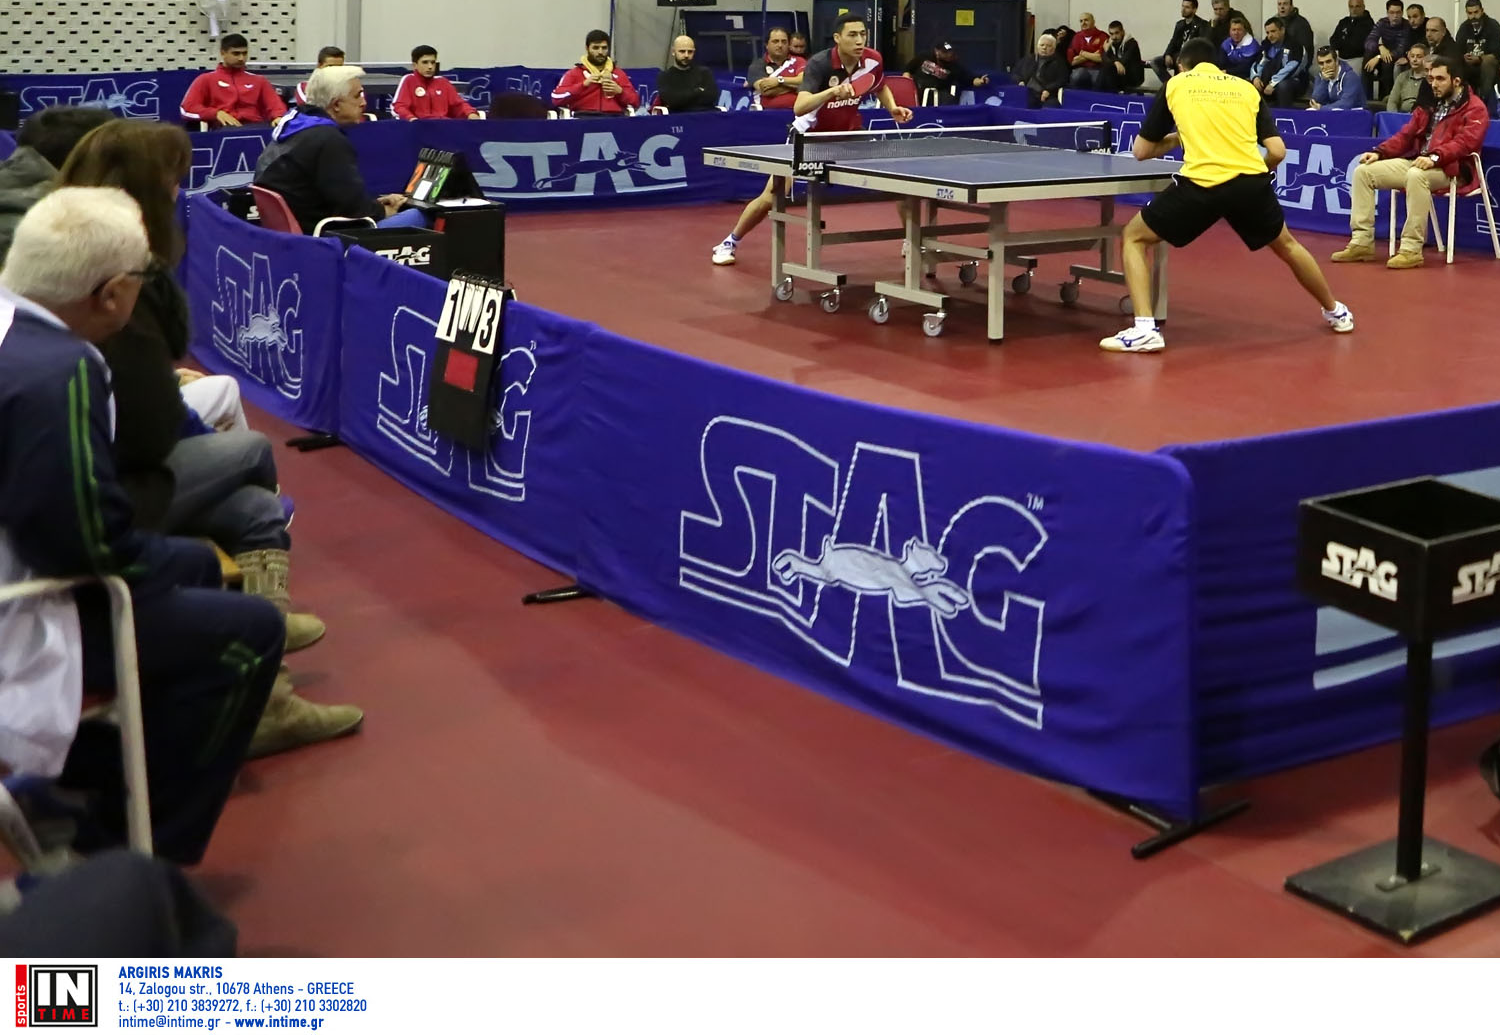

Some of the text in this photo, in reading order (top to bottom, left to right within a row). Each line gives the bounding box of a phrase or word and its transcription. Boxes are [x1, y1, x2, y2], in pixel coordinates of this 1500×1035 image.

[473, 131, 688, 199] STAG
[798, 161, 825, 171] JOOLA
[445, 287, 460, 337] 1
[478, 297, 497, 349] 3
[679, 415, 1049, 730] STAG
[1321, 541, 1399, 602] STAG
